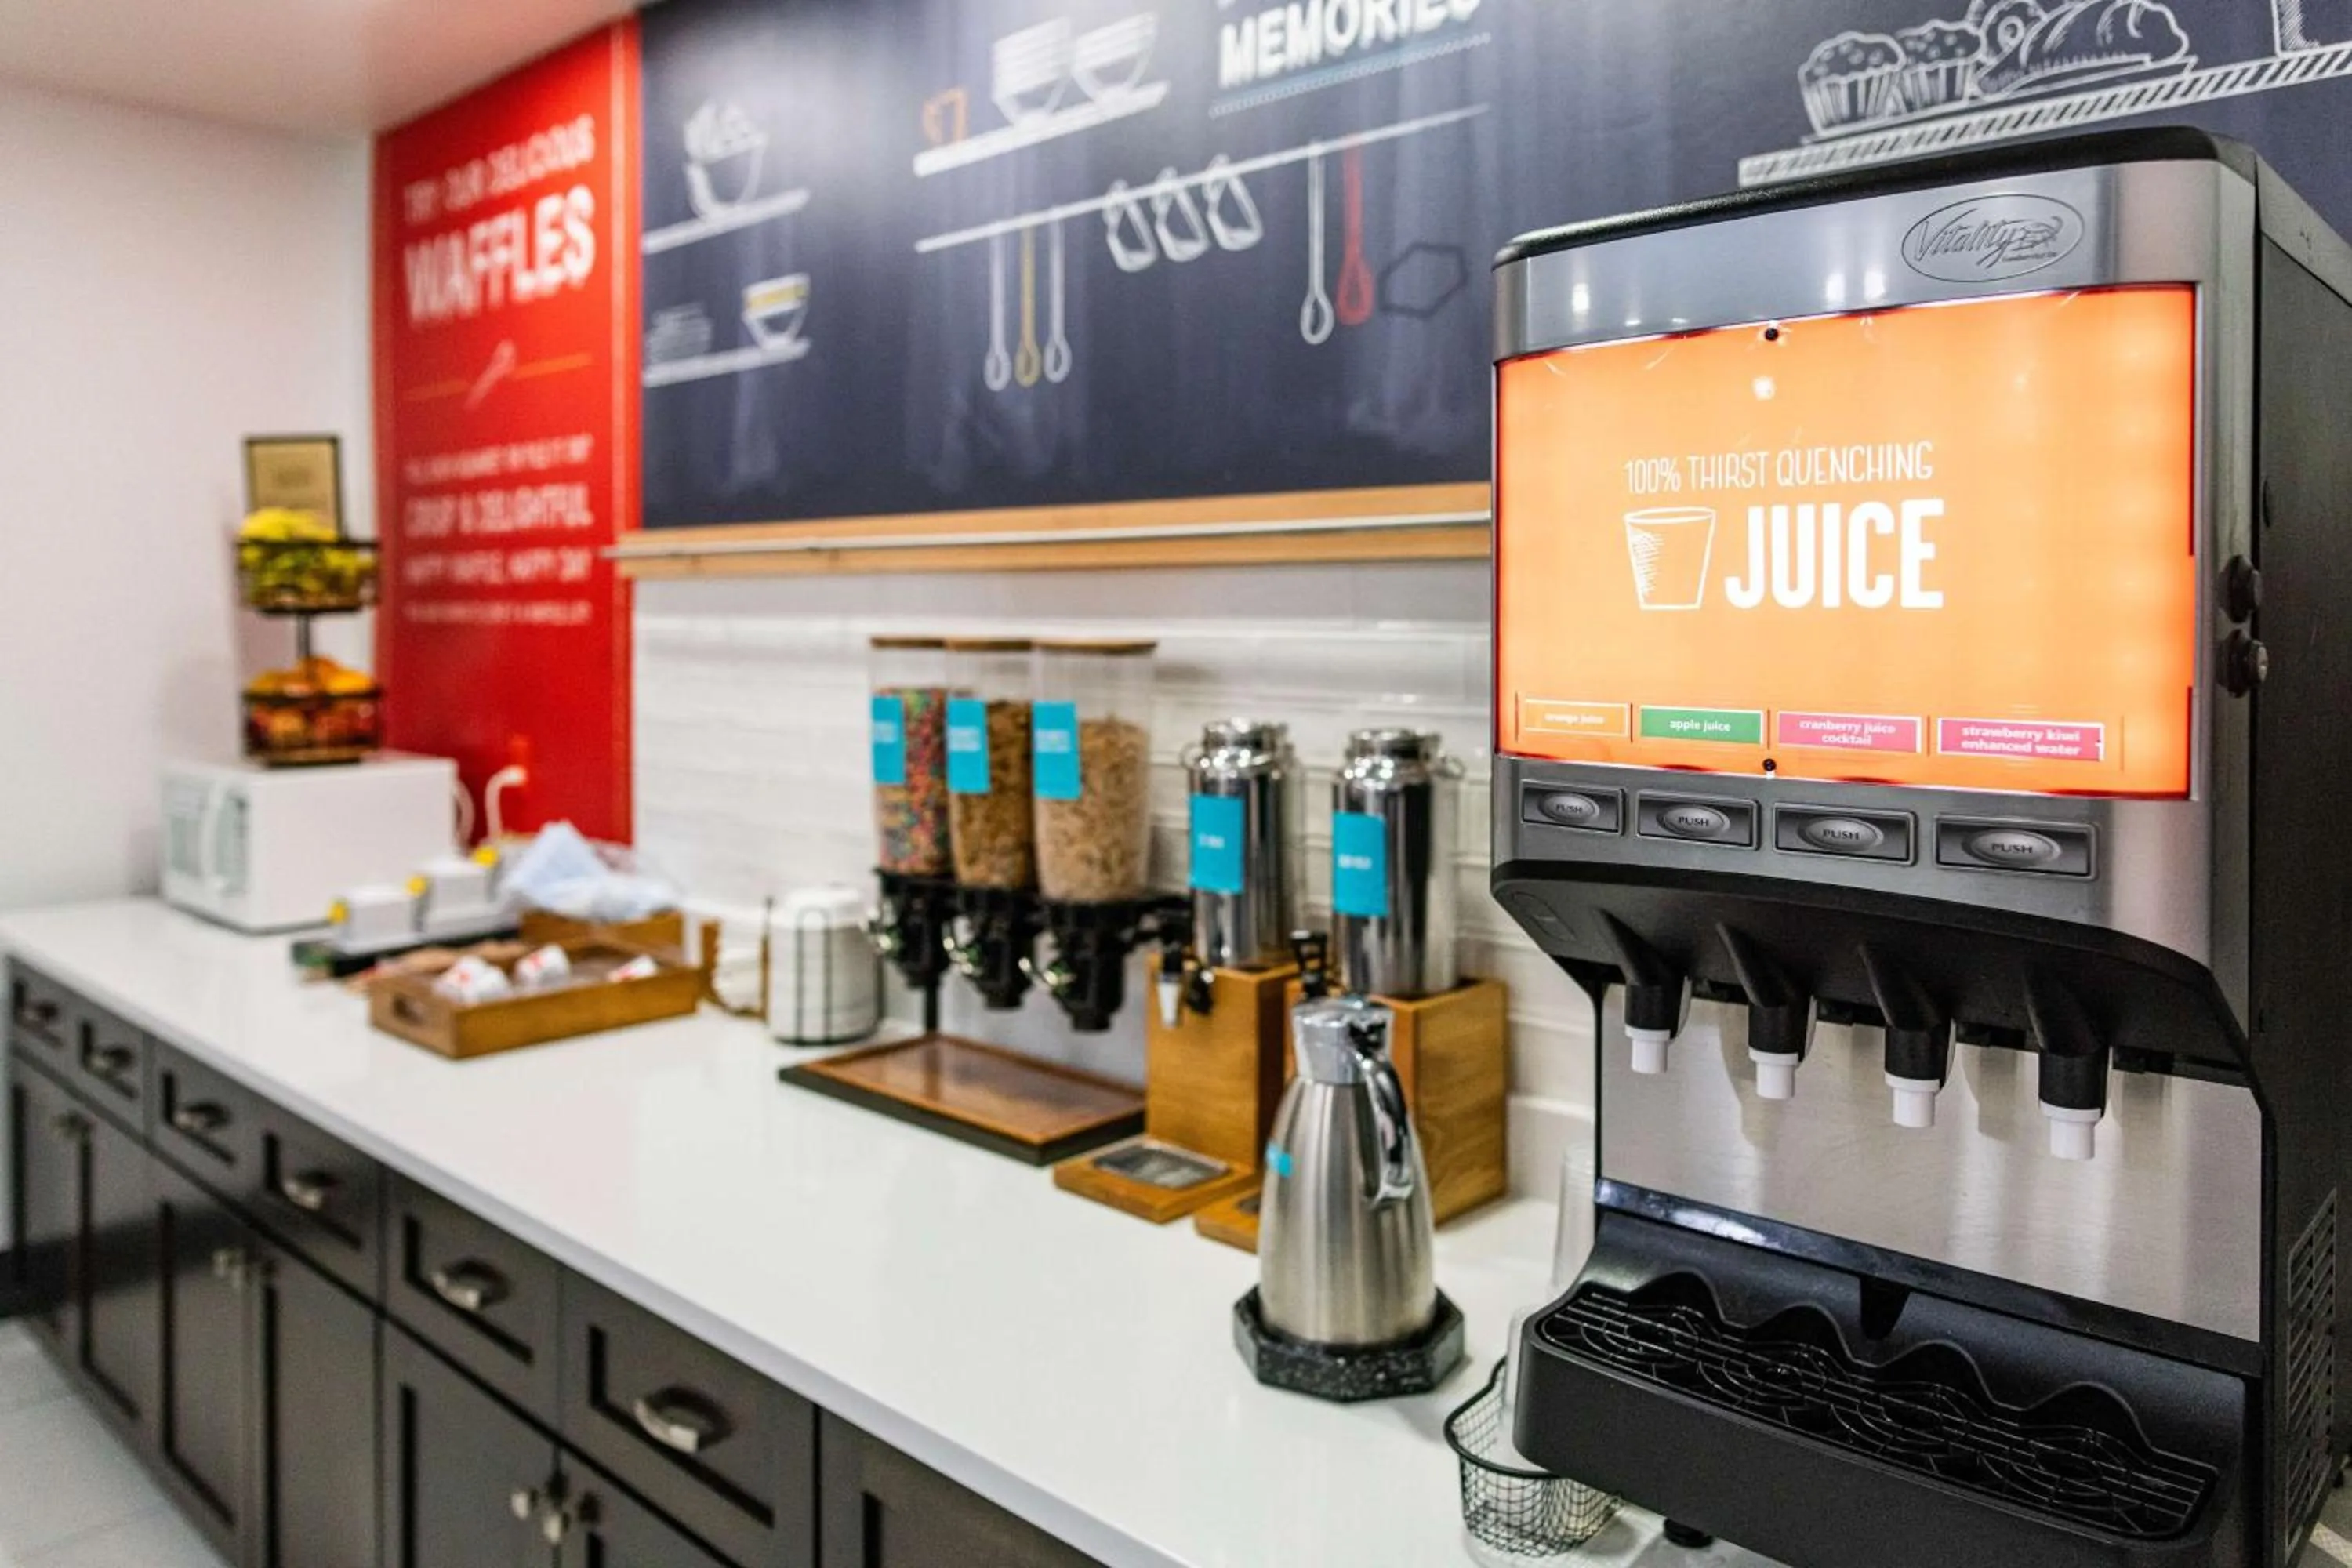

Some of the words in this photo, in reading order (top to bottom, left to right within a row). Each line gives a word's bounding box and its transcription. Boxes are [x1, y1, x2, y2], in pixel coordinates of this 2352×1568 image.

[1915, 208, 2032, 269] Vitality
[403, 184, 596, 324] WAFFLES
[1624, 457, 1681, 494] 100%
[1687, 450, 1769, 490] THIRST
[1776, 441, 1933, 487] QUENCHING
[1724, 498, 1944, 609] JUICE
[1669, 719, 1702, 732] apple
[1703, 720, 1732, 733] juice
[1798, 720, 1861, 735] cranberry
[1864, 722, 1896, 735] juice
[1821, 732, 1871, 746] cocktail
[1962, 726, 2043, 743] strawberry
[2046, 729, 2080, 742] kiwi
[1961, 739, 2033, 753] enhanced
[2035, 743, 2081, 756] water
[1555, 804, 1583, 814] PUSH
[1678, 816, 1709, 827] PUSH
[1822, 829, 1860, 840] PUSH
[1991, 843, 2034, 855] PUSH
